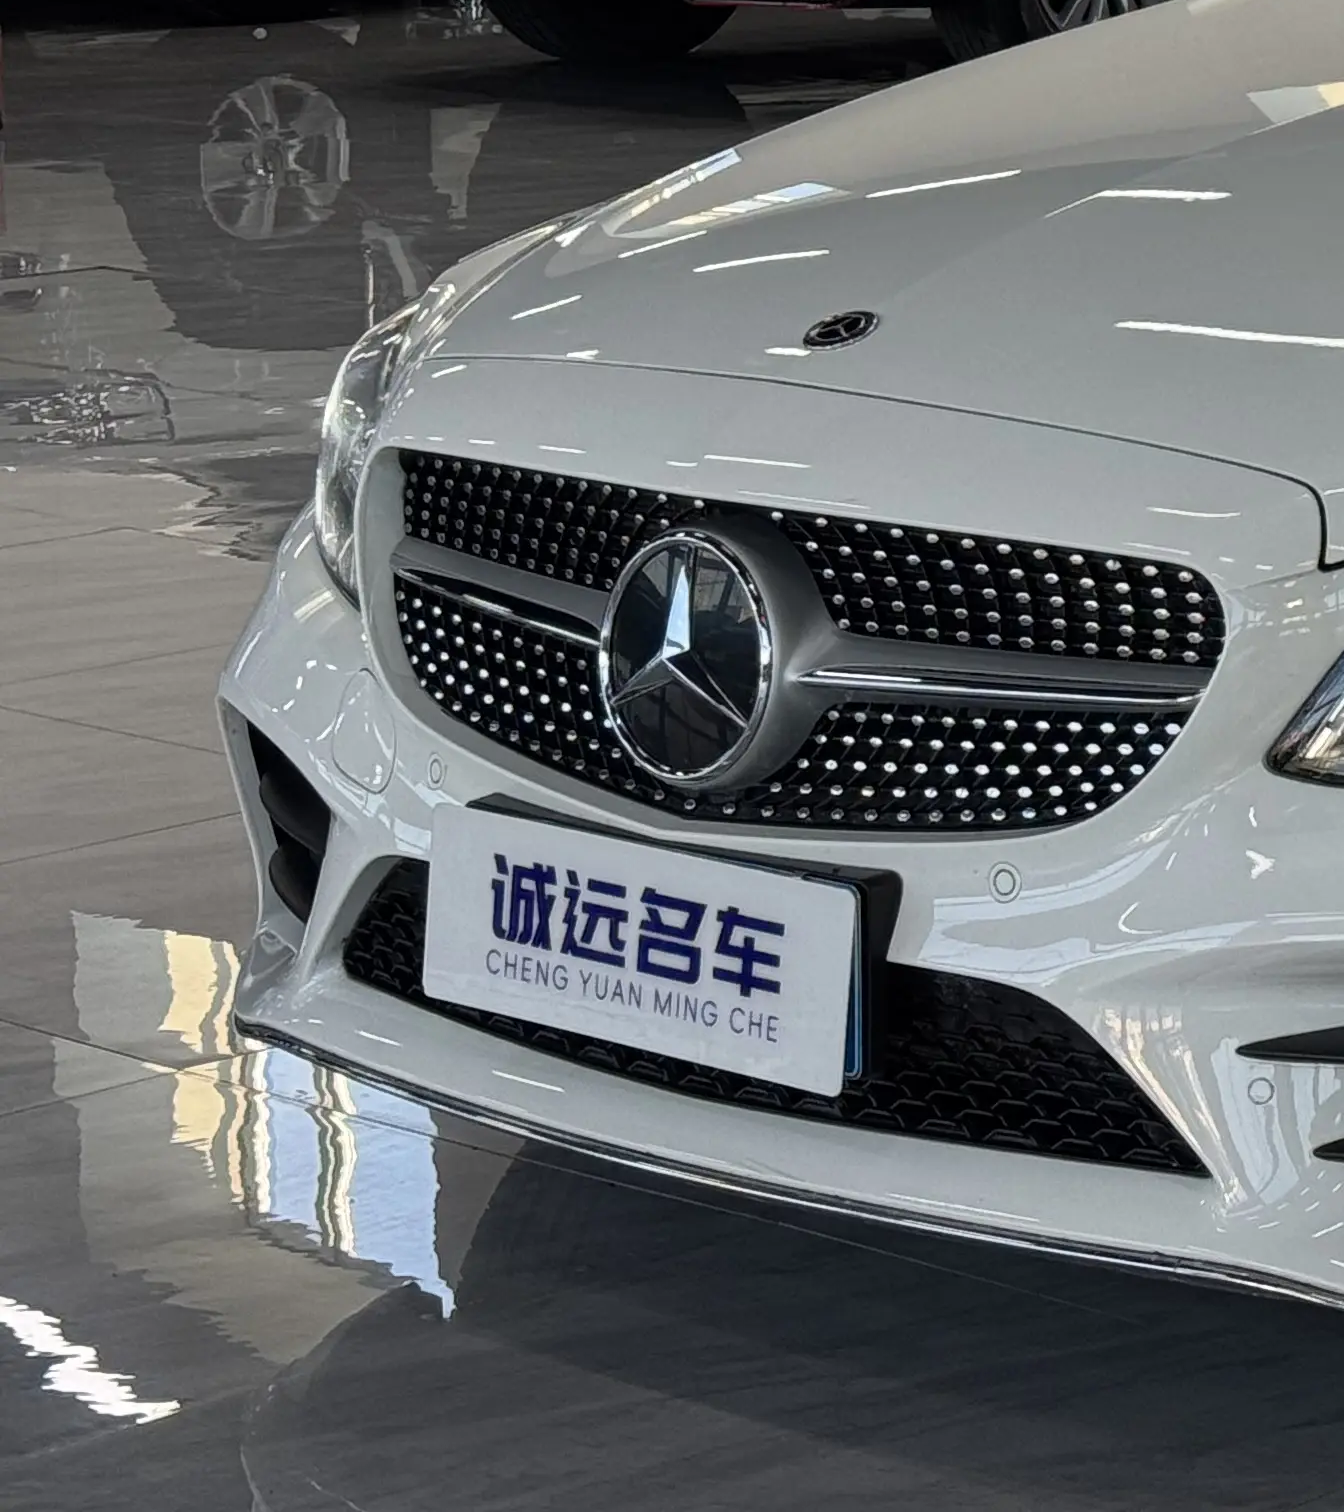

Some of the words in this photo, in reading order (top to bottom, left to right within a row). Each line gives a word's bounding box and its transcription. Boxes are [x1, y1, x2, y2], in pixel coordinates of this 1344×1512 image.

[490, 852, 786, 998] 诚远名车
[485, 948, 570, 991] CHENG
[578, 968, 643, 1010] YUAN
[653, 988, 719, 1028] MING
[728, 1007, 780, 1043] CHE
